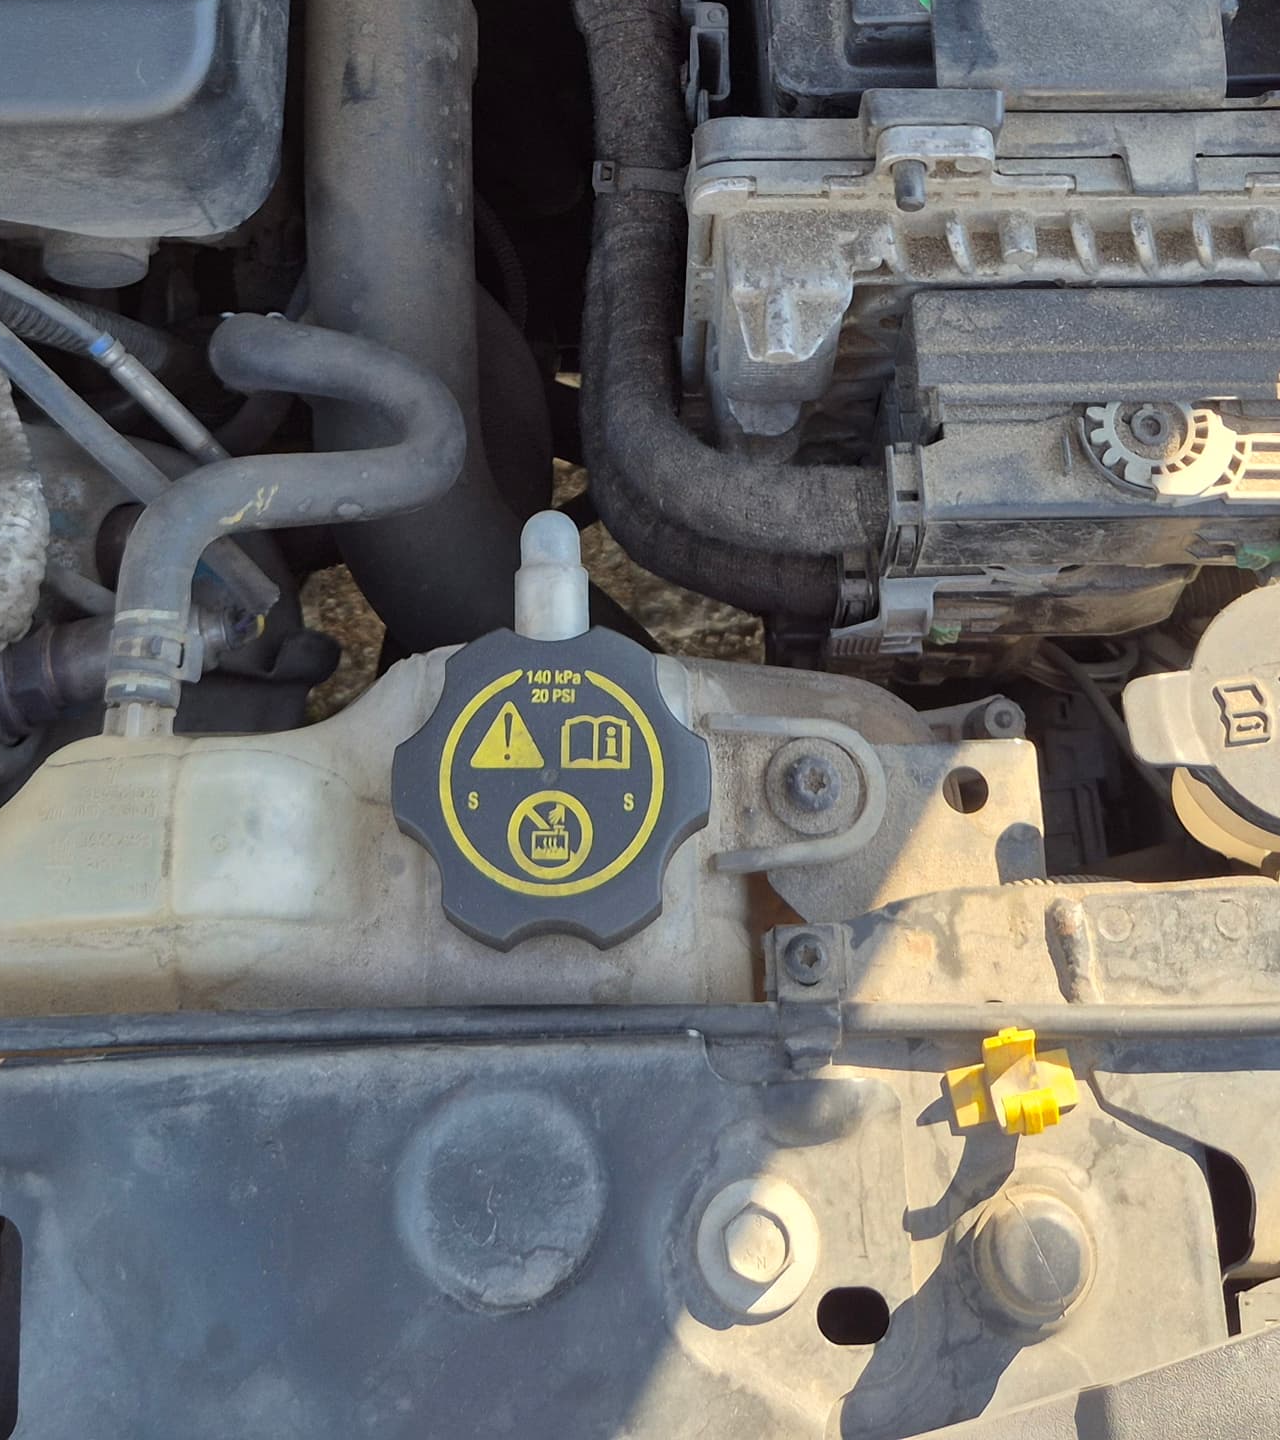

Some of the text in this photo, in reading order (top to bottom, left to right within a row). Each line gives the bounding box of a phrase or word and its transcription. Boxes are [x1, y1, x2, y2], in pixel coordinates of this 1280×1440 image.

[526, 669, 582, 686] 140 kPa
[530, 688, 576, 703] 20 PSI
[467, 792, 480, 811] S
[623, 793, 635, 812] S
